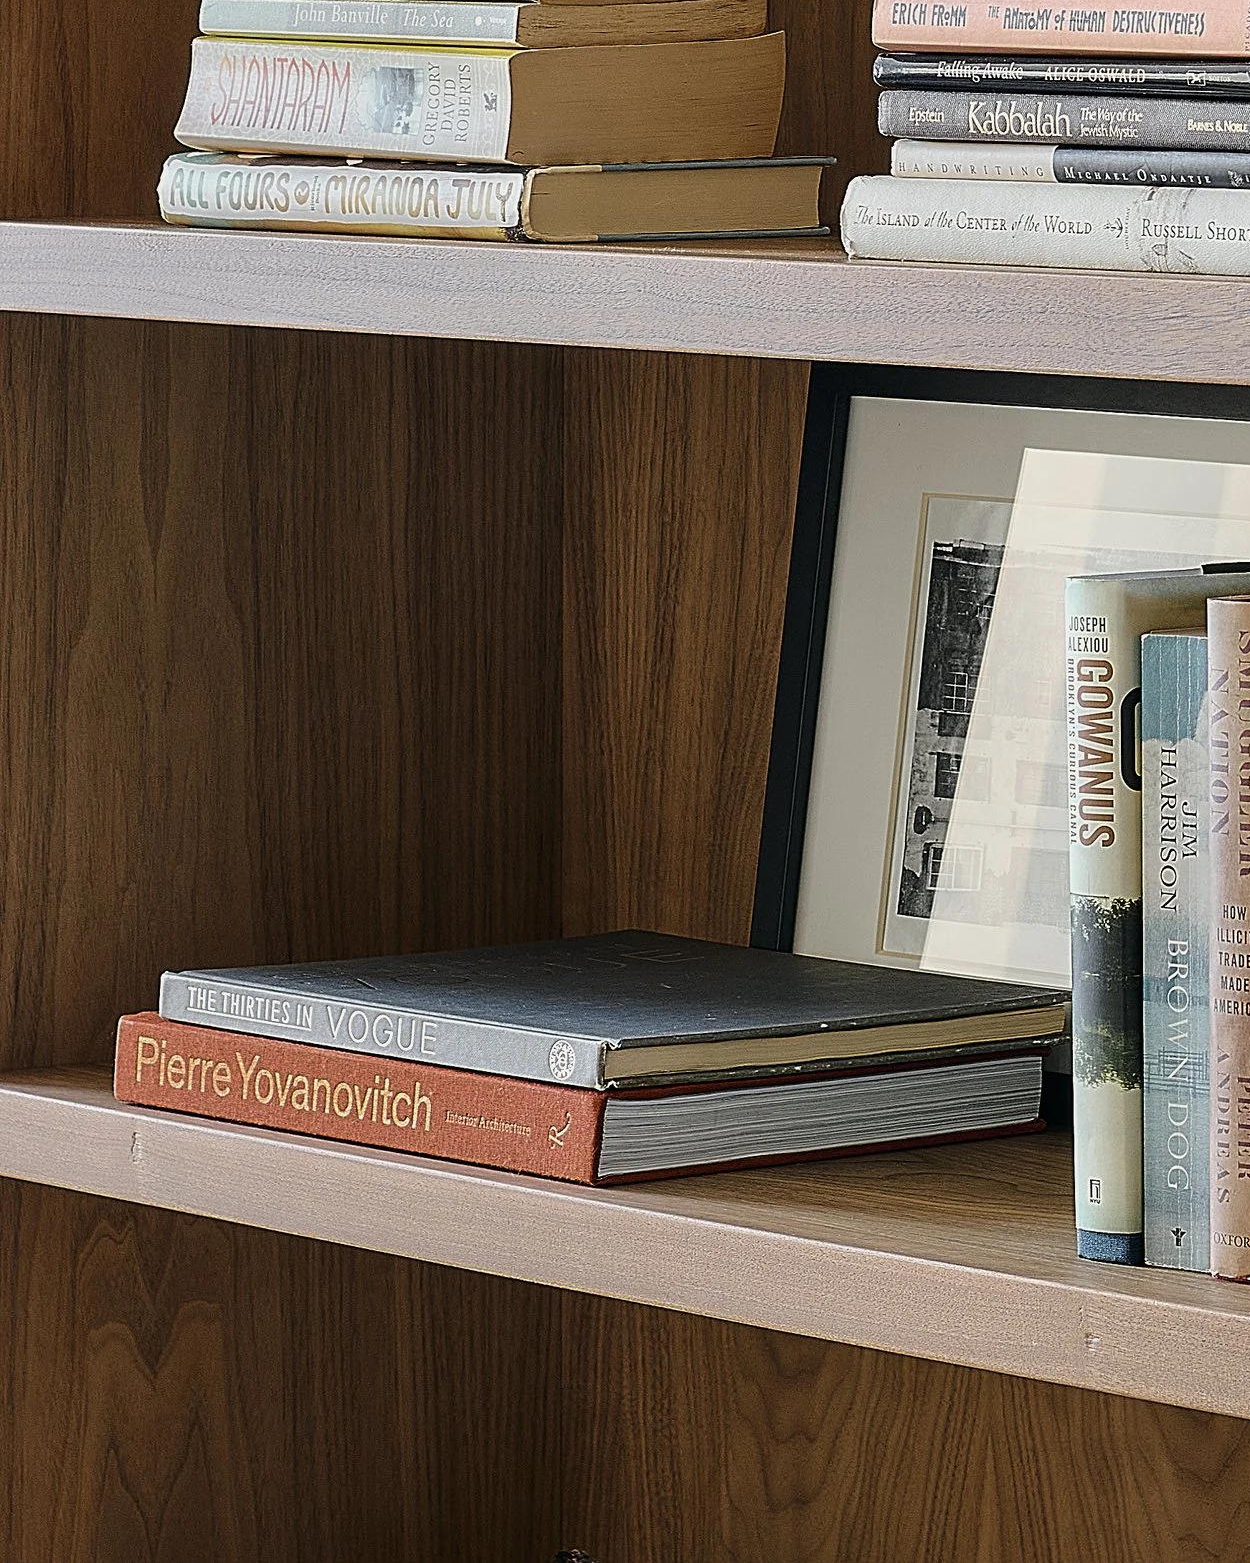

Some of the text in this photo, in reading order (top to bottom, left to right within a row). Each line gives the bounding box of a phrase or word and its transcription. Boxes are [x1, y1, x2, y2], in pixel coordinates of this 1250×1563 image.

[292, 3, 388, 26] John Banville
[423, 62, 441, 146] GREGORY
[441, 78, 456, 132] DAVID
[455, 64, 471, 142] ROBERTS
[909, 101, 1071, 137] Epstein Kabbalah
[1064, 166, 1212, 184] MICHAEL ONDAATJE
[1141, 218, 1202, 240] RUSSELL
[1070, 617, 1106, 632] JOSEPH
[1070, 637, 1108, 653] ALEXIOU
[1077, 659, 1114, 848] GOWANUS
[1160, 747, 1177, 912] HARRISON
[1182, 801, 1198, 858] JIM
[1223, 904, 1246, 920] HOW
[1220, 975, 1250, 992] MADE
[188, 986, 438, 1055] THE THIRTIES IN VOGUE
[135, 1035, 431, 1132] Pierre Yovanovitch
